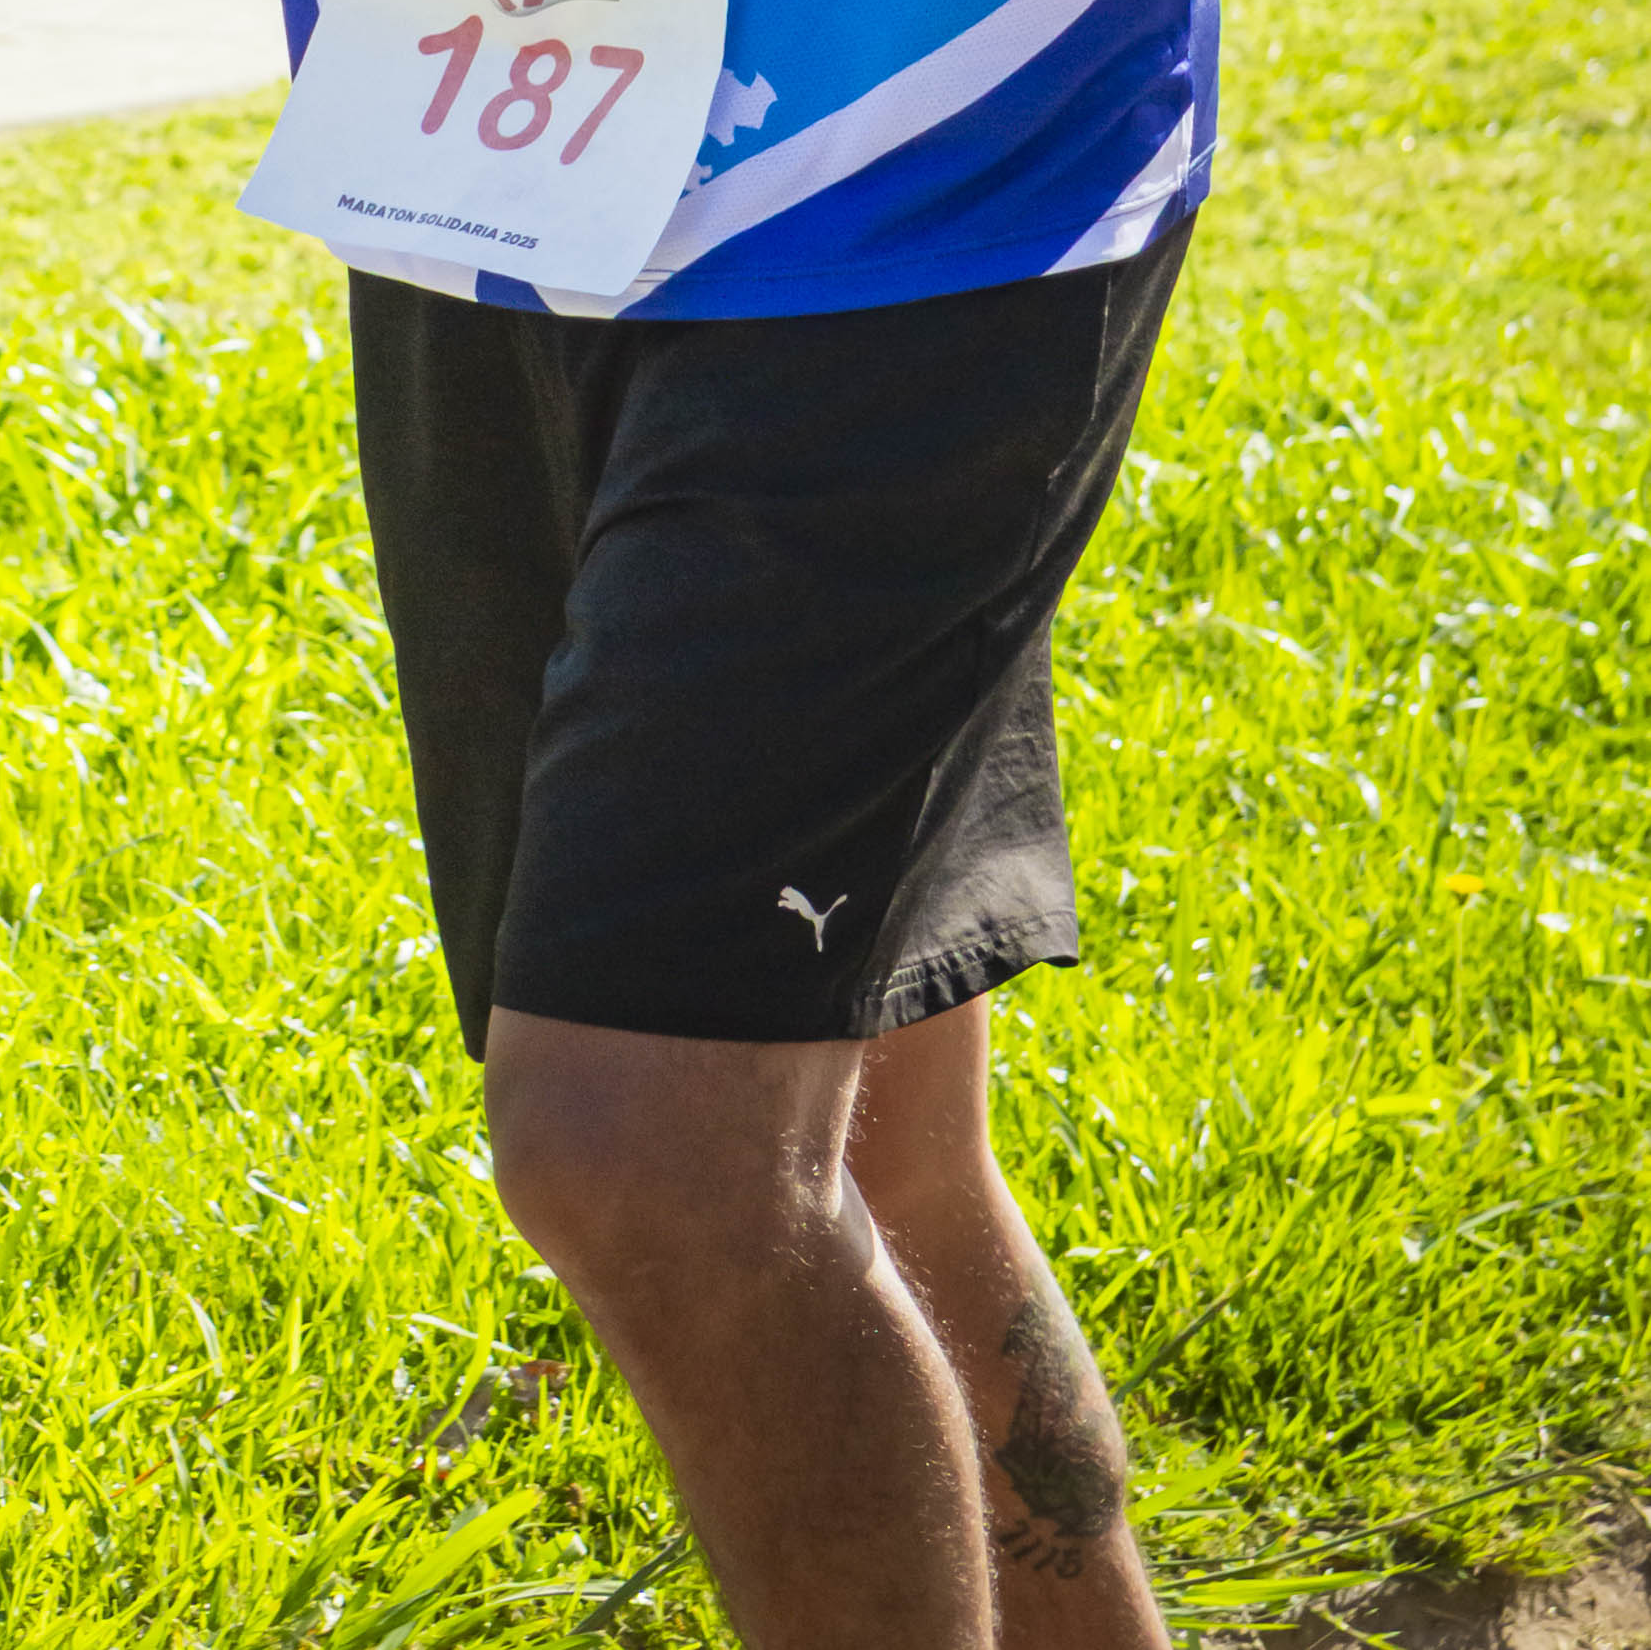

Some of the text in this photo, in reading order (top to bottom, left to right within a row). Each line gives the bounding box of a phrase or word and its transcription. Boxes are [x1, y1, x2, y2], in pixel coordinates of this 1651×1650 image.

[418, 14, 645, 166] 187
[337, 194, 539, 250] MARATON SOLIDARIA 2025
